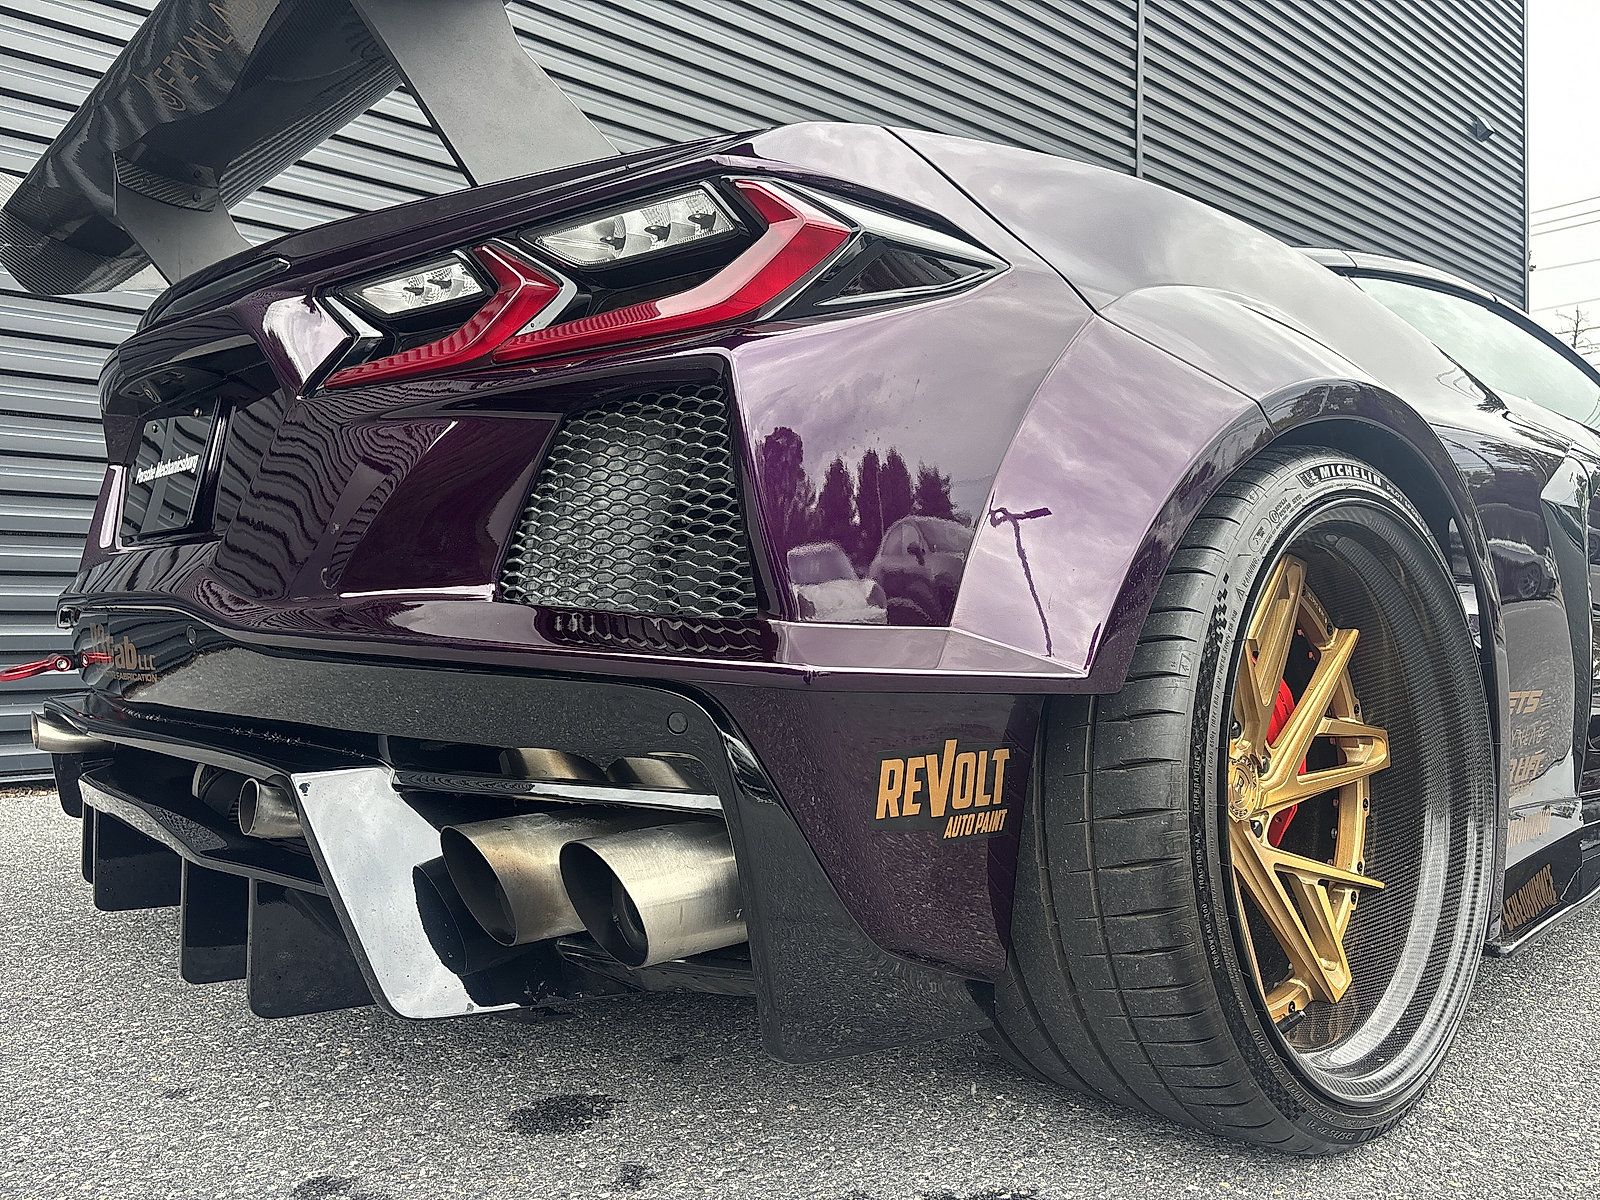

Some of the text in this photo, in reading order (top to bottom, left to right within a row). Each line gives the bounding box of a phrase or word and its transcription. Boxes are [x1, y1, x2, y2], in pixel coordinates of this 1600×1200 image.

[1319, 464, 1382, 487] MICHELIN
[137, 654, 156, 671] LLC
[1193, 753, 1201, 816] TEMPERATURE
[943, 809, 1008, 840] AUTO PAINT
[1195, 849, 1206, 890] TRACTION
